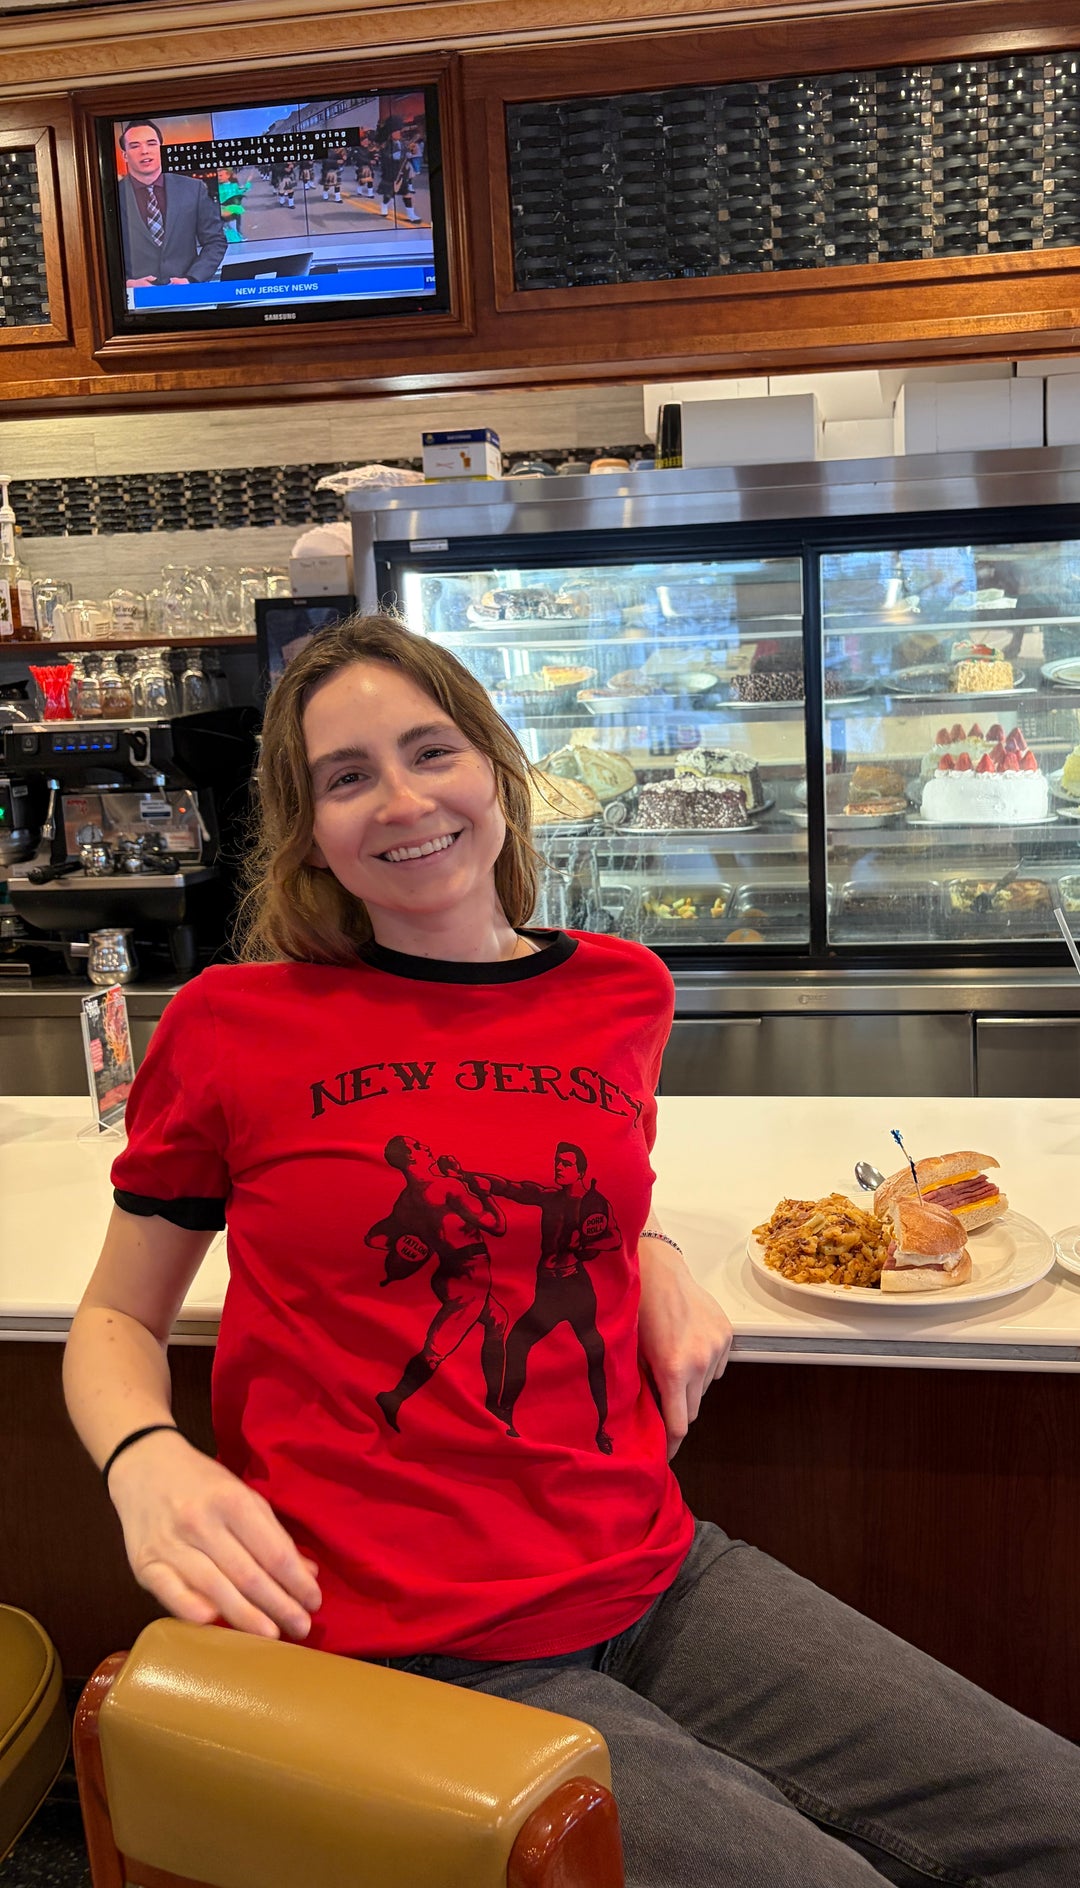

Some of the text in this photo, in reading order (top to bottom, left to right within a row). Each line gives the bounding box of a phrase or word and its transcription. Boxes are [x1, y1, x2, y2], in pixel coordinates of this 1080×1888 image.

[211, 140, 242, 149] Looks
[250, 137, 274, 145] like
[283, 133, 307, 141] it's
[314, 131, 346, 140] going
[186, 151, 217, 160] stick
[225, 147, 262, 157] around
[269, 143, 314, 153] heading
[322, 140, 347, 148] into
[168, 163, 192, 172] next
[257, 156, 275, 164] but
[283, 153, 314, 161] enjoy
[235, 282, 319, 296] NEW JERSEY NEWS
[264, 312, 297, 321] SAMSUNG
[310, 1059, 646, 1129] NEW JERSEY
